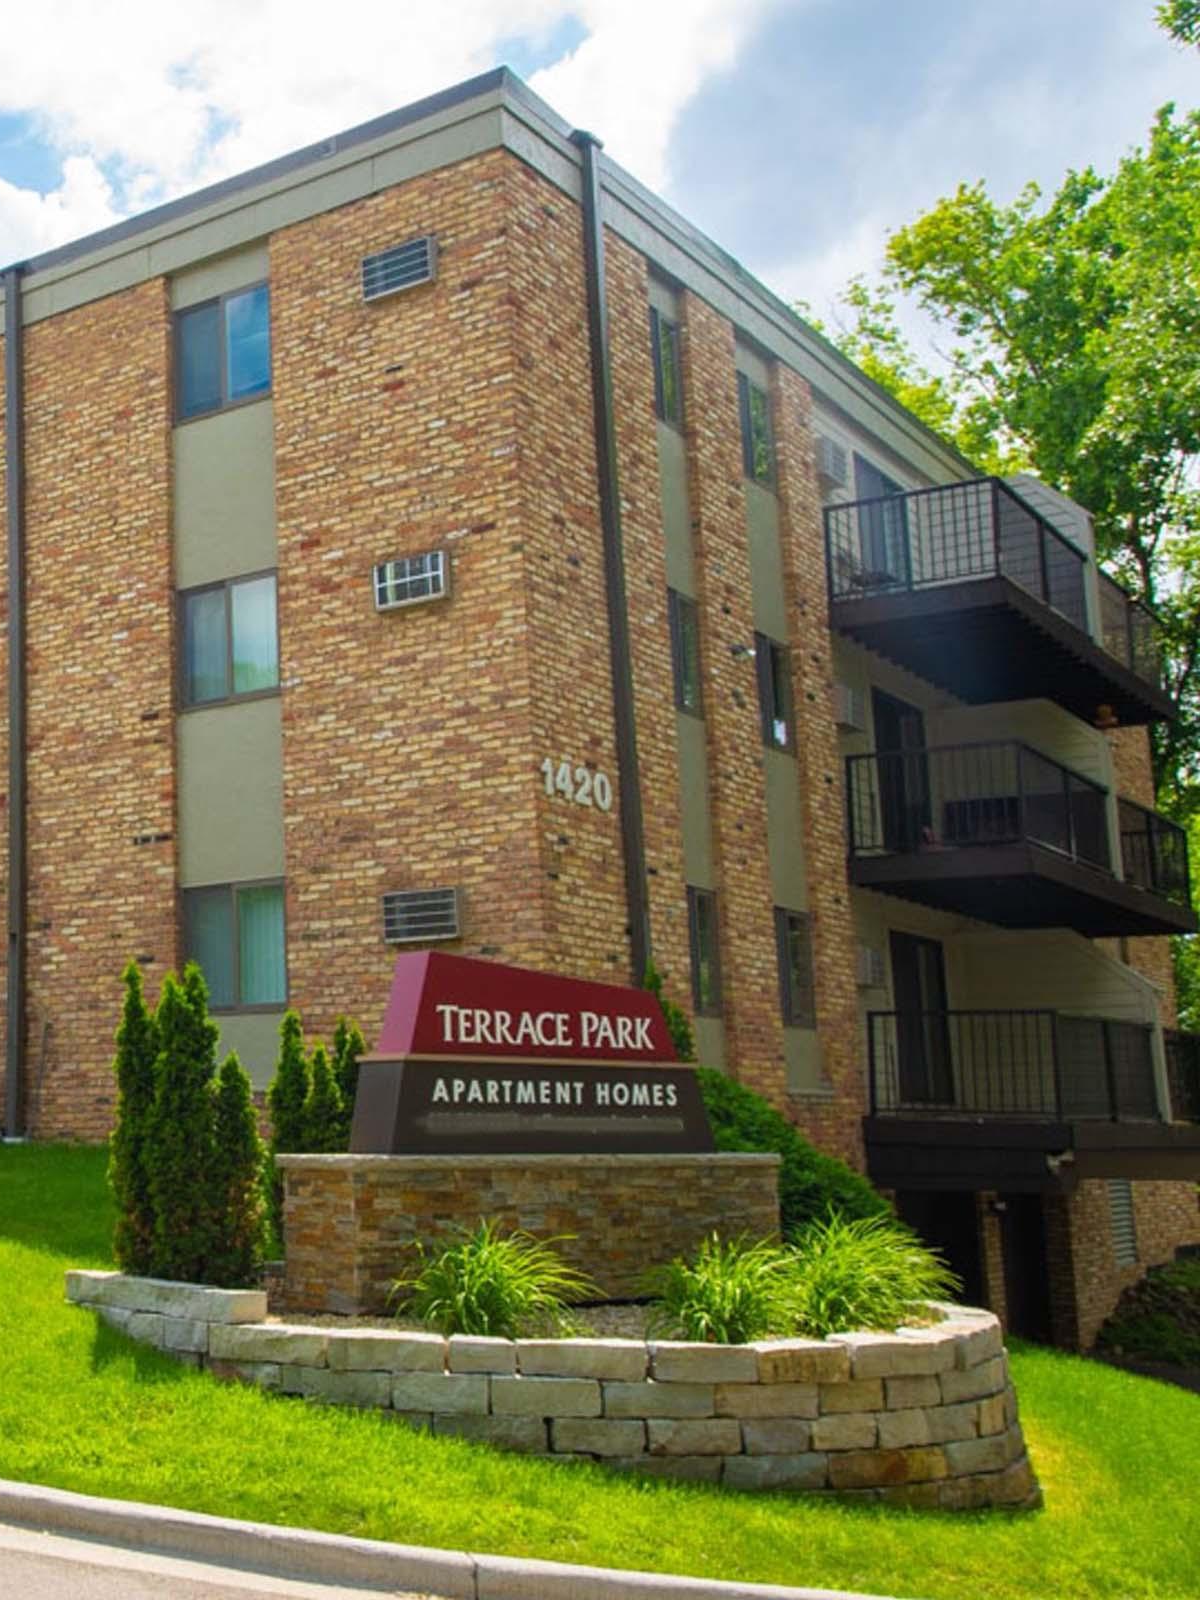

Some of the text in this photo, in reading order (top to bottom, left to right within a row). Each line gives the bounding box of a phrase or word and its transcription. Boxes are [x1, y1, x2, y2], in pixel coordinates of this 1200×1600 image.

[541, 757, 613, 811] 1420
[436, 1004, 655, 1050] TERRACE PARK
[432, 1078, 678, 1107] APARTMENT HOMES
